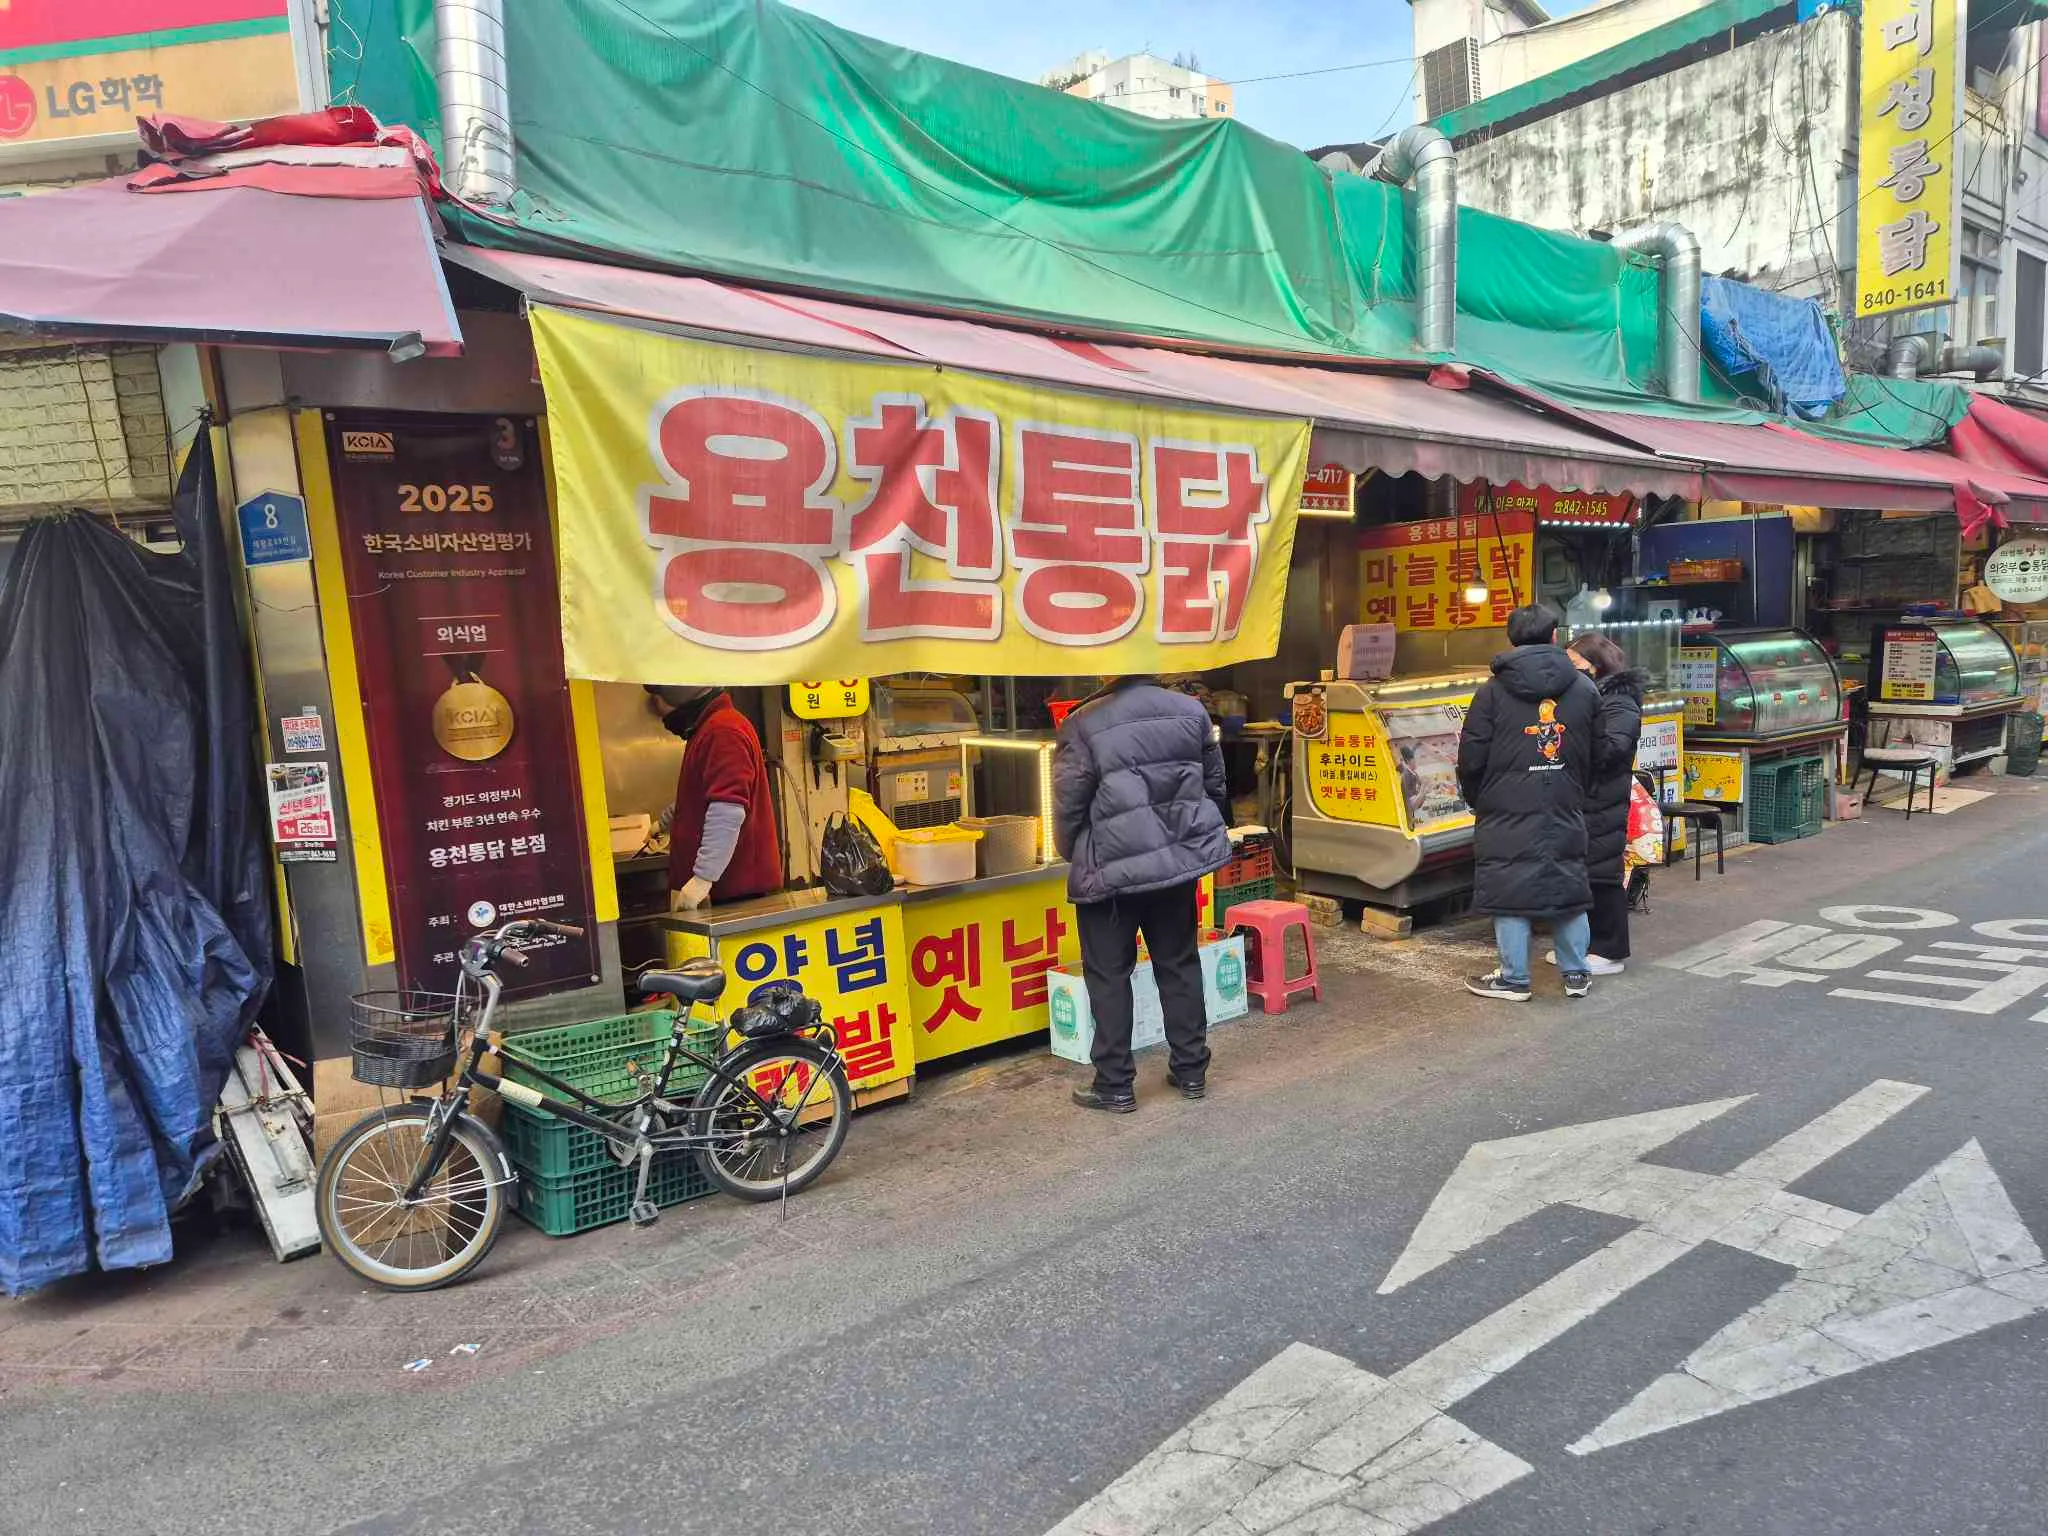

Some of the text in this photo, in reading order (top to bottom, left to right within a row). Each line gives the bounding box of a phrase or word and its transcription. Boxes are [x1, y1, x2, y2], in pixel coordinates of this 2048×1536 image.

[46, 73, 163, 118] LG화학
[1864, 279, 1946, 309] 840-1641
[346, 435, 388, 448] KCIA
[397, 484, 494, 512] 2025
[264, 503, 278, 529] 8
[641, 391, 1269, 645] 용천통닭
[362, 532, 532, 553] 한국소비자산업평가
[1408, 519, 1477, 543] 용천통닭
[1366, 542, 1525, 589] 마늘통닭
[1366, 586, 1524, 627] 옛날통닭
[436, 625, 487, 643] 외식업
[1320, 753, 1377, 767] 후라이드
[442, 787, 521, 808] 경기도 의정부시
[1320, 785, 1377, 801] 옛날통닭
[426, 807, 543, 832] 치킨 부문 3년 연속 우수
[428, 833, 546, 869] 용천통닭 본점
[735, 916, 888, 1007] 양념
